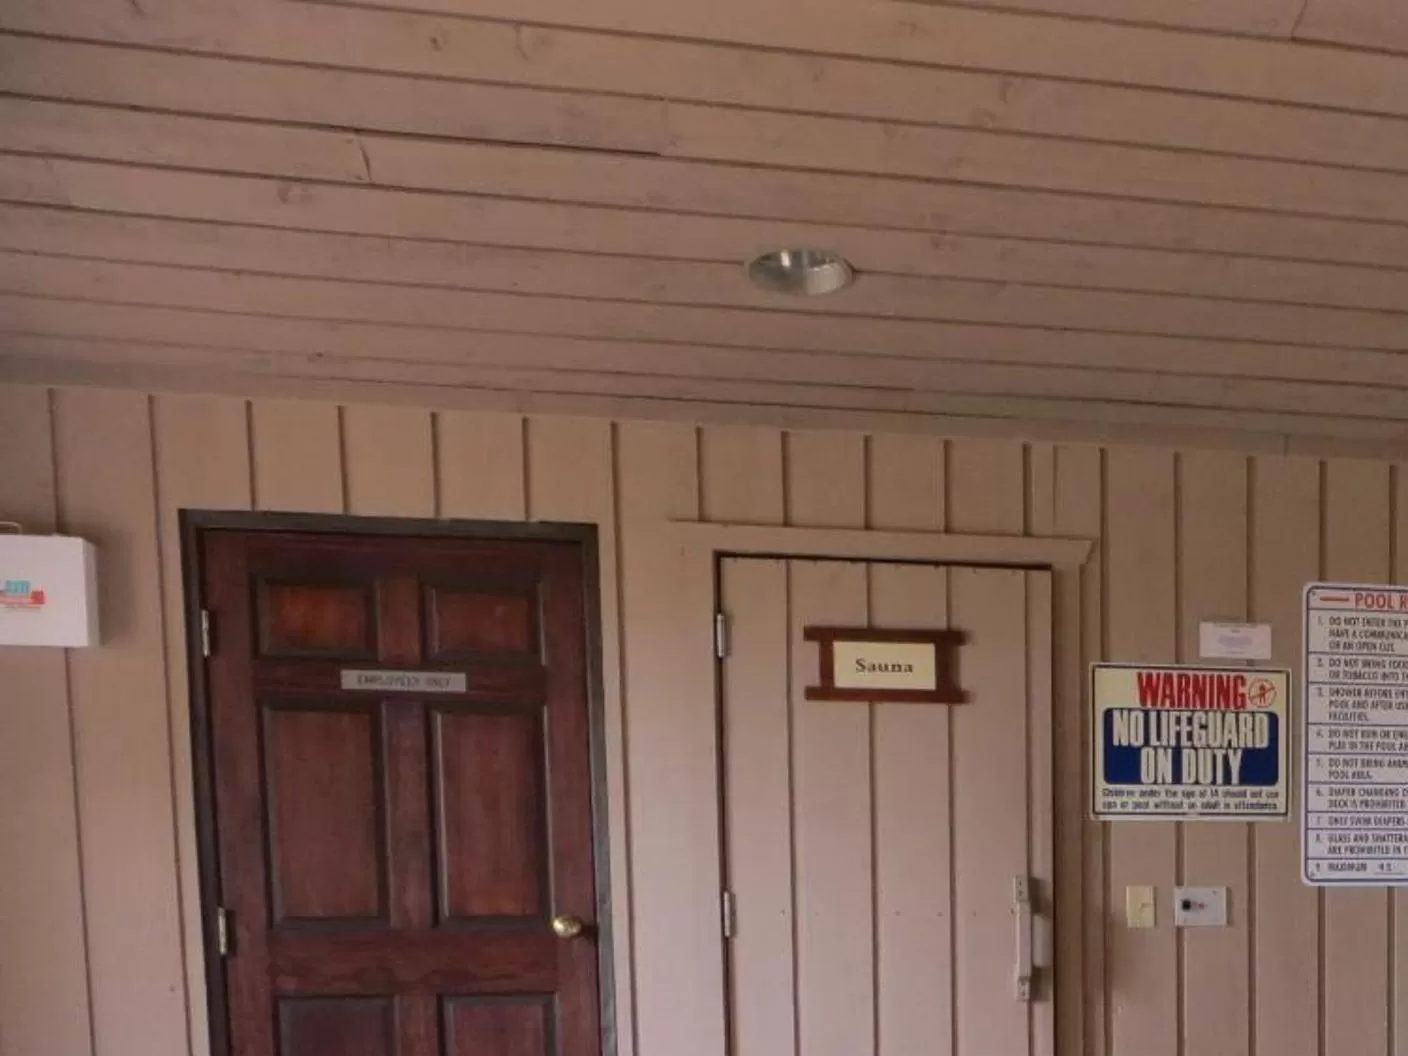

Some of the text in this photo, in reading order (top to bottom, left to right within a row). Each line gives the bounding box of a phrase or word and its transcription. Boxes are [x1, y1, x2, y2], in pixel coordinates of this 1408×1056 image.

[1355, 593, 1394, 609] POOL
[1344, 617, 1358, 626] NOT
[1362, 618, 1385, 627] ENTER
[1388, 619, 1402, 628] THE
[1329, 630, 1348, 638] HAVE
[1352, 631, 1357, 639] A
[1343, 642, 1354, 650] AN
[1356, 642, 1376, 651] OPEN
[856, 658, 914, 673] Sauna
[1329, 660, 1341, 668] DO
[1344, 660, 1359, 668] NOT
[1362, 660, 1385, 669] BRING
[1329, 671, 1340, 679] OR
[1343, 672, 1379, 680] TOBACCO
[1381, 672, 1399, 681] INTO
[1137, 672, 1248, 709] WARNING
[1365, 689, 1393, 698] BEFORE
[1329, 701, 1349, 709] POOL
[1352, 701, 1368, 710] AND
[1371, 702, 1393, 710] AFTER
[1113, 710, 1269, 748] NO LIFEGUARD
[1329, 729, 1341, 738] DO
[1343, 730, 1358, 739] NOT
[1361, 730, 1378, 739] RUN
[1380, 730, 1390, 739] OR
[1329, 741, 1346, 750] PLAY
[1349, 742, 1357, 750] IN
[1360, 742, 1373, 750] THE
[1376, 742, 1396, 751] POOL
[1140, 747, 1244, 785] ON DUTY
[1329, 758, 1340, 767] DO
[1343, 758, 1358, 767] NOT
[1361, 759, 1385, 768] BRING
[1329, 771, 1349, 779] POOL
[1328, 800, 1348, 808] DECK
[1353, 834, 1369, 843] AND
[1328, 846, 1341, 854] ARE
